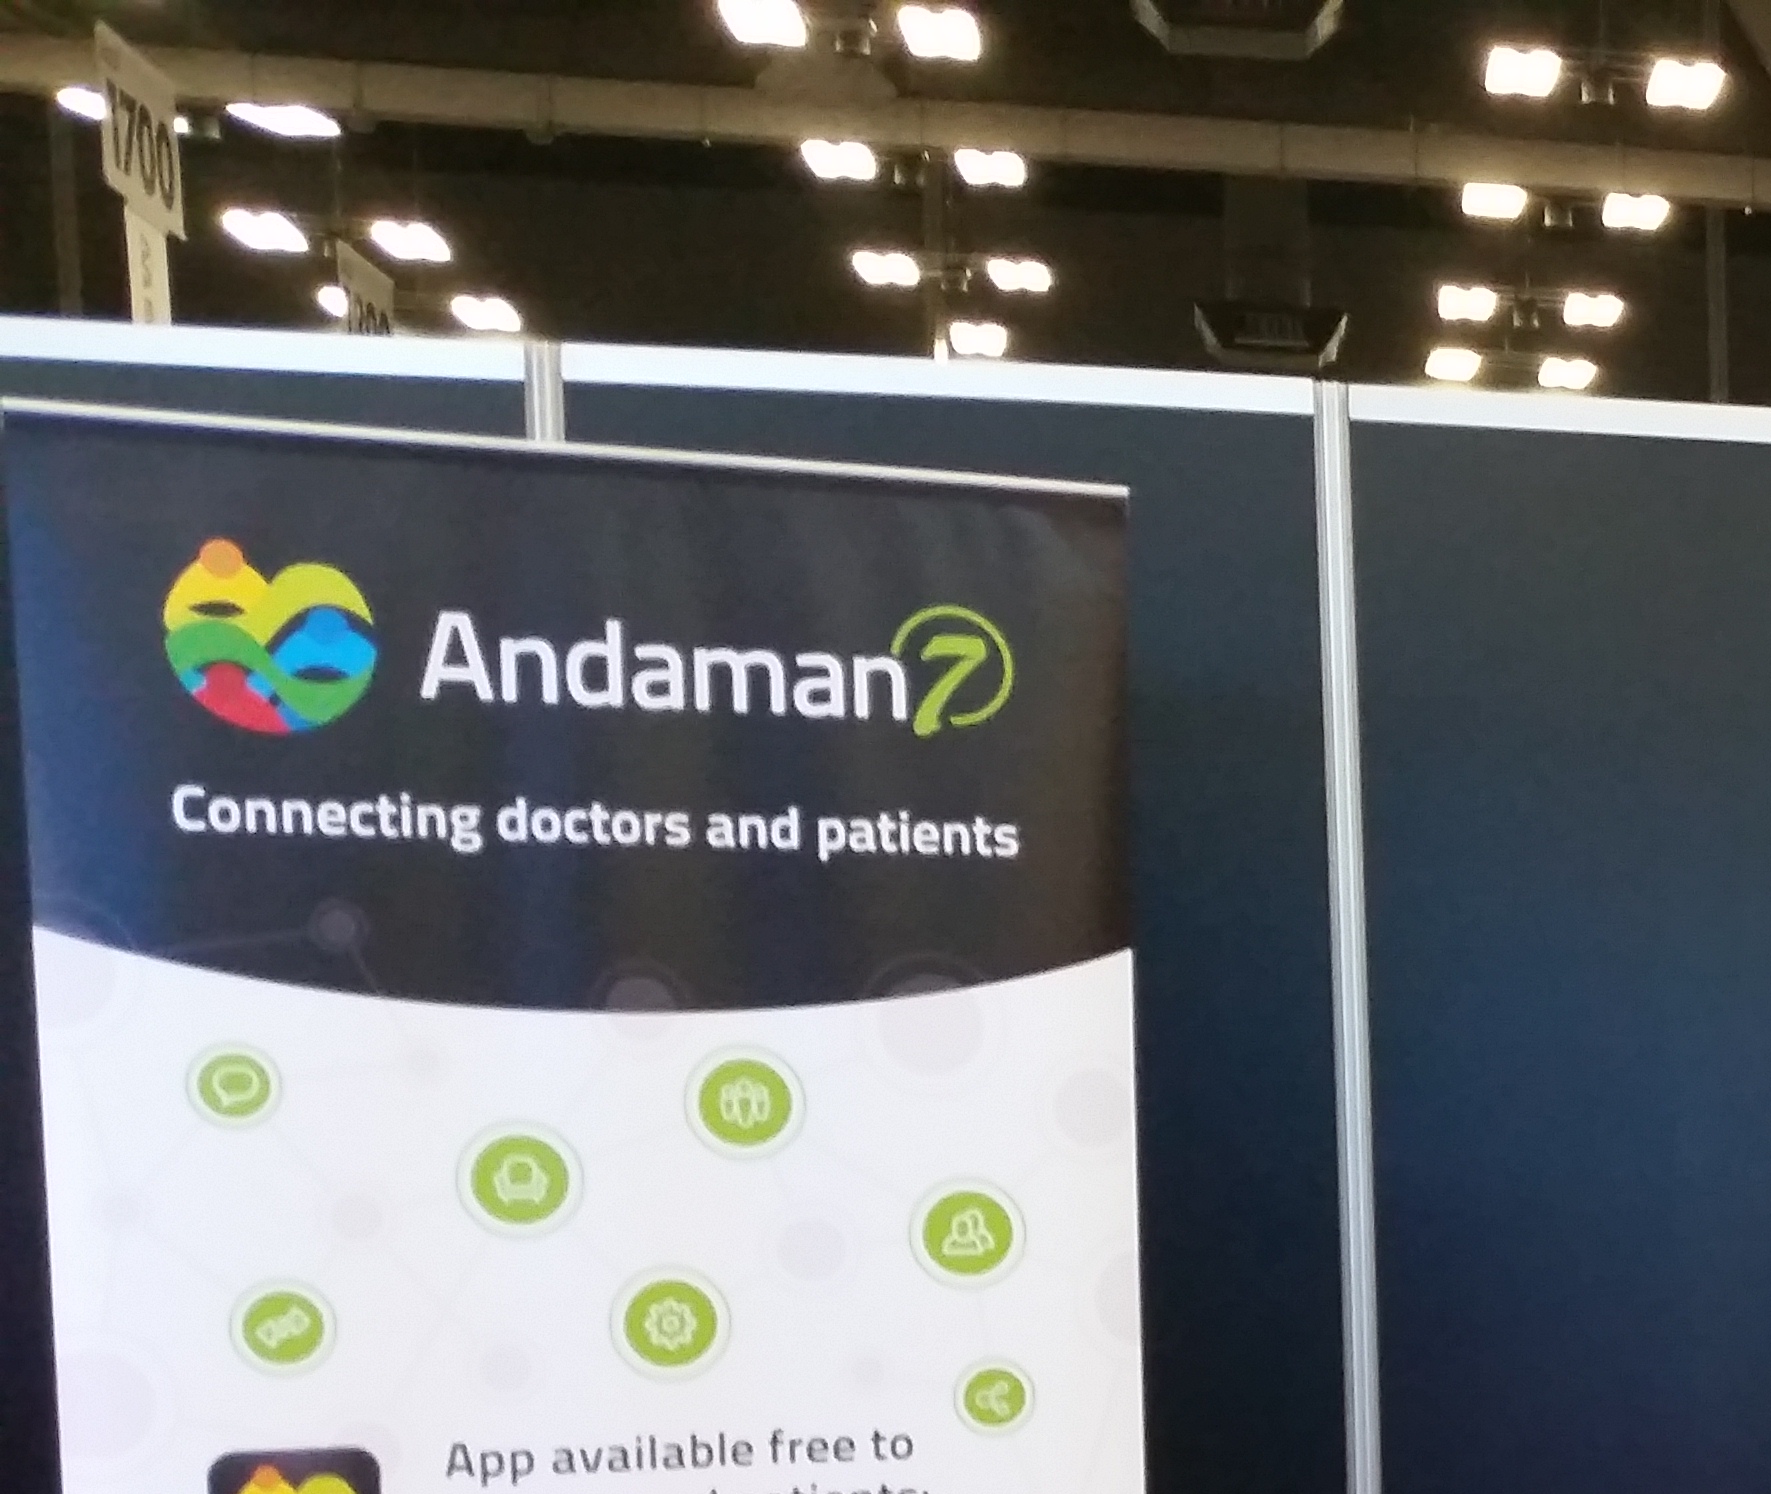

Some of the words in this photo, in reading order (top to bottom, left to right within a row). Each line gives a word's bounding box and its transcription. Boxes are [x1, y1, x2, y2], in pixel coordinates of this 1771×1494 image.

[420, 605, 1014, 736] Andaman7
[172, 784, 482, 853] Connecting
[497, 796, 690, 848] doctors
[705, 806, 800, 851] and
[816, 809, 1019, 862] patients
[445, 1441, 535, 1486] App
[551, 1433, 754, 1477] available
[769, 1428, 856, 1465] free
[871, 1428, 914, 1462] to
